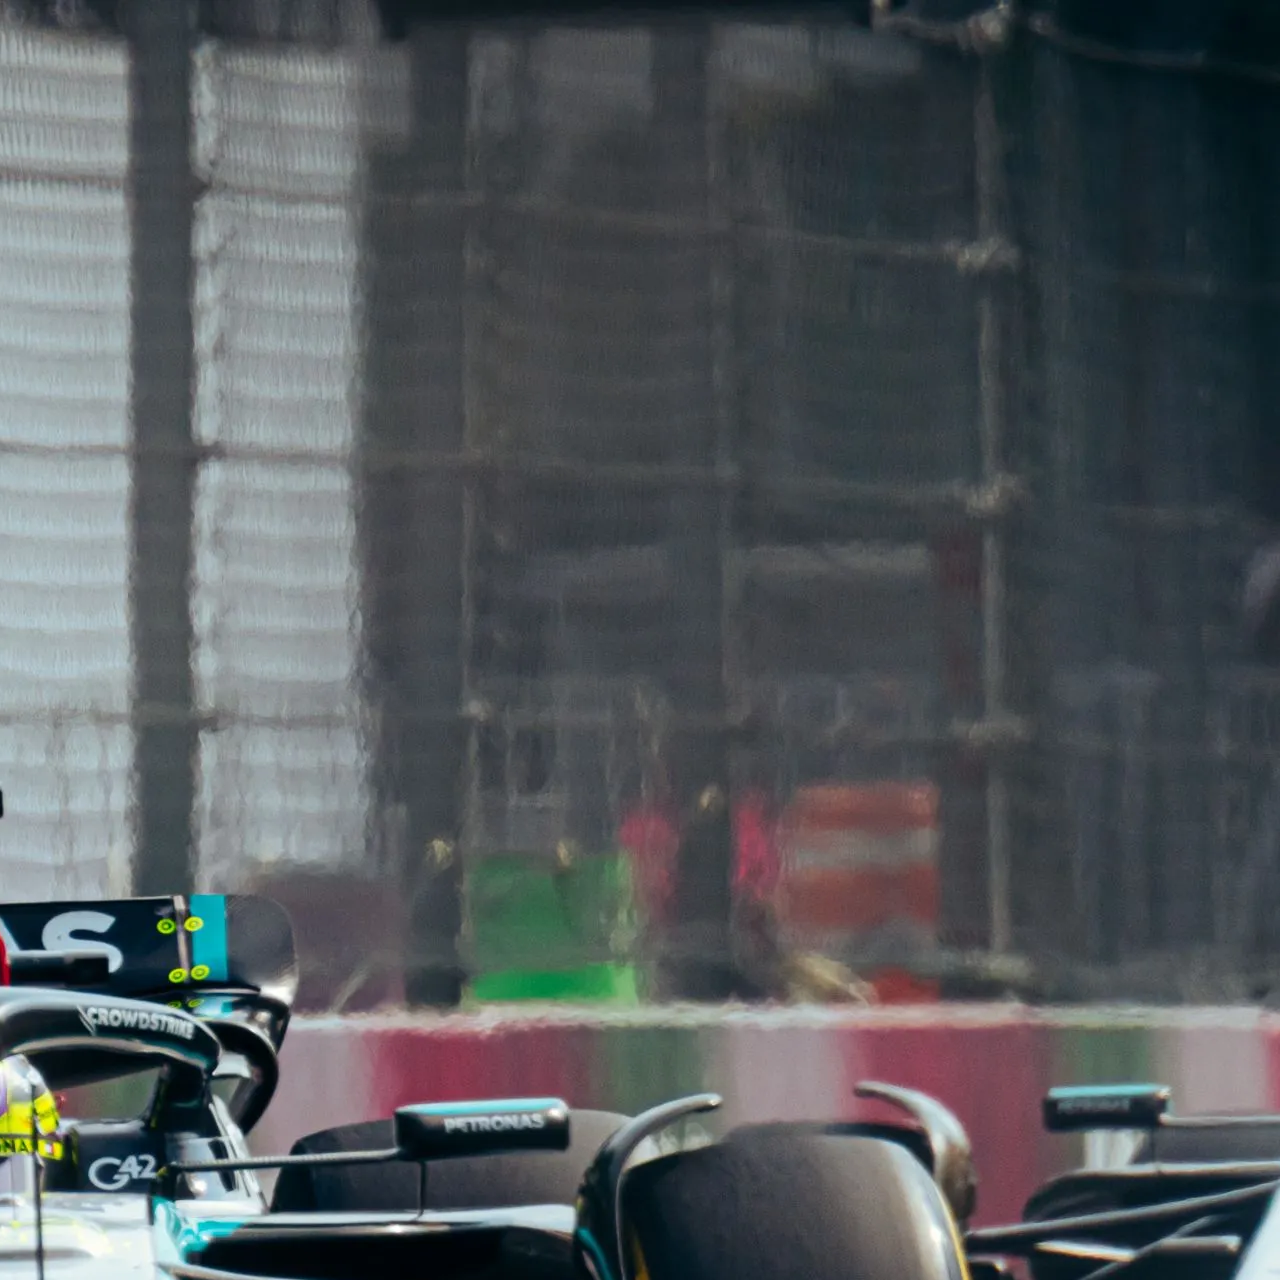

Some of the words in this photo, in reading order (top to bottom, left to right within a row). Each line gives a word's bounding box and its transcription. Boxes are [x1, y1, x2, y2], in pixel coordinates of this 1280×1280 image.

[86, 1006, 196, 1040] CROWDSTRIKE
[443, 1112, 545, 1133] PETRONAS
[87, 1153, 158, 1191] G42
